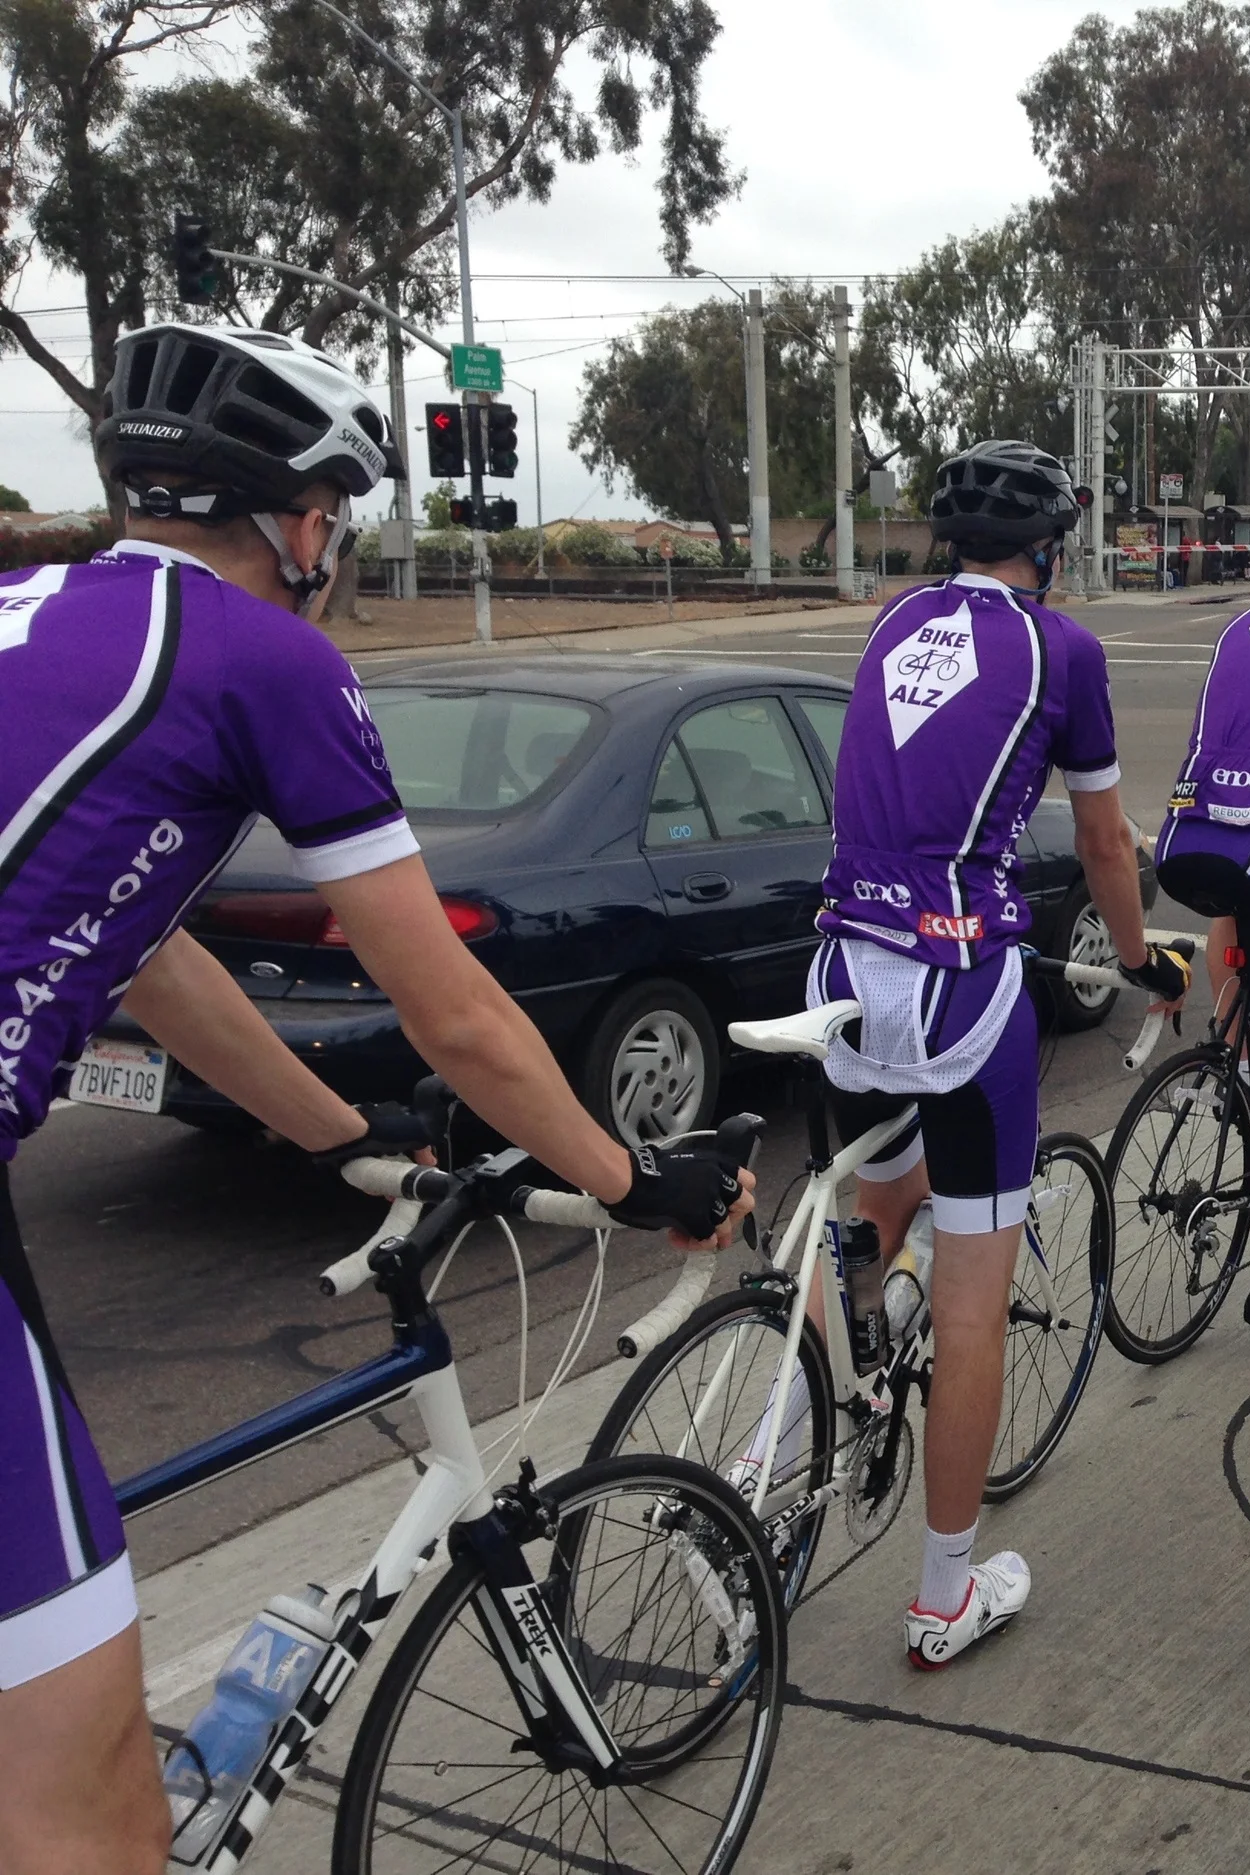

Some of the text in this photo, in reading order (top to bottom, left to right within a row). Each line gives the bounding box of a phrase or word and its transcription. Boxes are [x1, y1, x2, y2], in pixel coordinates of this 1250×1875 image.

[118, 422, 183, 440] SPECIALIZED
[917, 627, 971, 649] BIKE
[888, 683, 944, 709] ALZ
[931, 914, 980, 939] CLIF
[79, 1062, 157, 1102] 7BVF108
[512, 1592, 553, 1658] TREK
[204, 1565, 404, 1871] TREK
